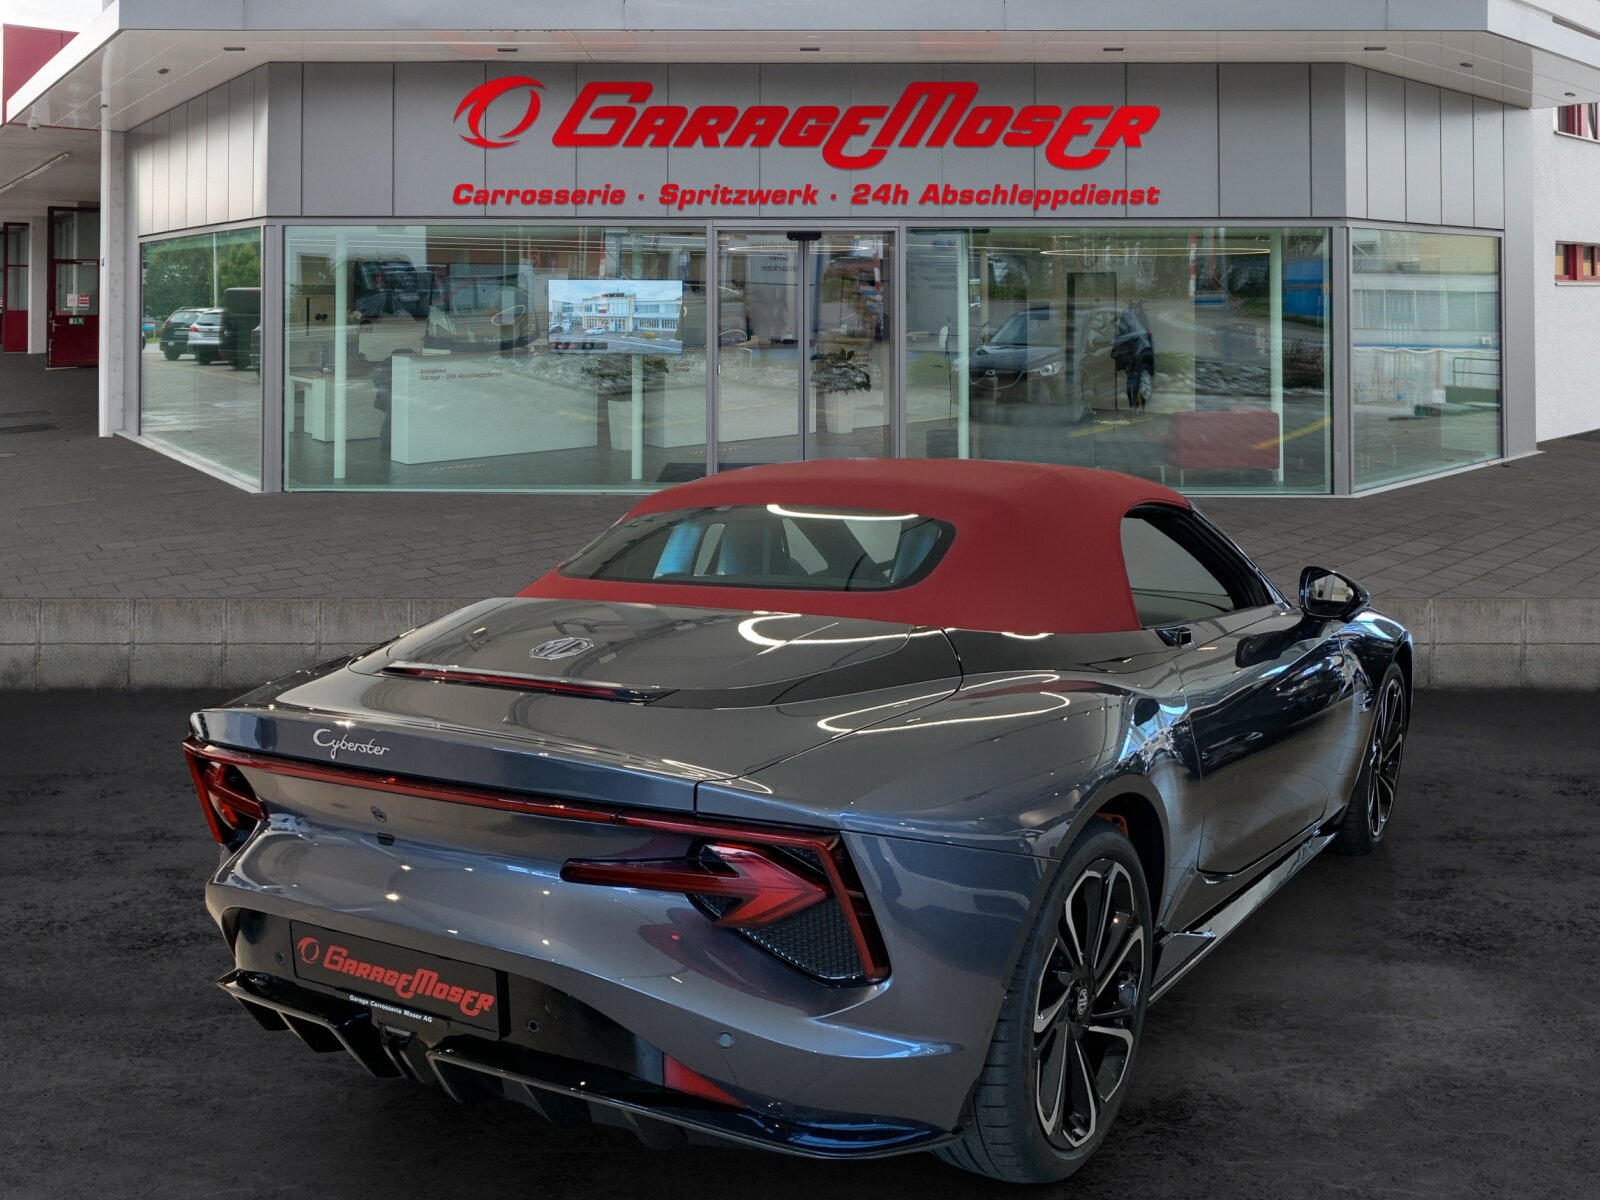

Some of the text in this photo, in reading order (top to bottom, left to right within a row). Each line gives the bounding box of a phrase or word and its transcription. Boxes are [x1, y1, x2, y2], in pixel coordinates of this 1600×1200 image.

[452, 183, 1161, 210] Carrosserie Spritzwerk 24h Abschleppdienst
[420, 374, 440, 382] Garage
[313, 728, 390, 760] Cyberster
[349, 994, 433, 1023] Garage Carrosserie Moser AG
